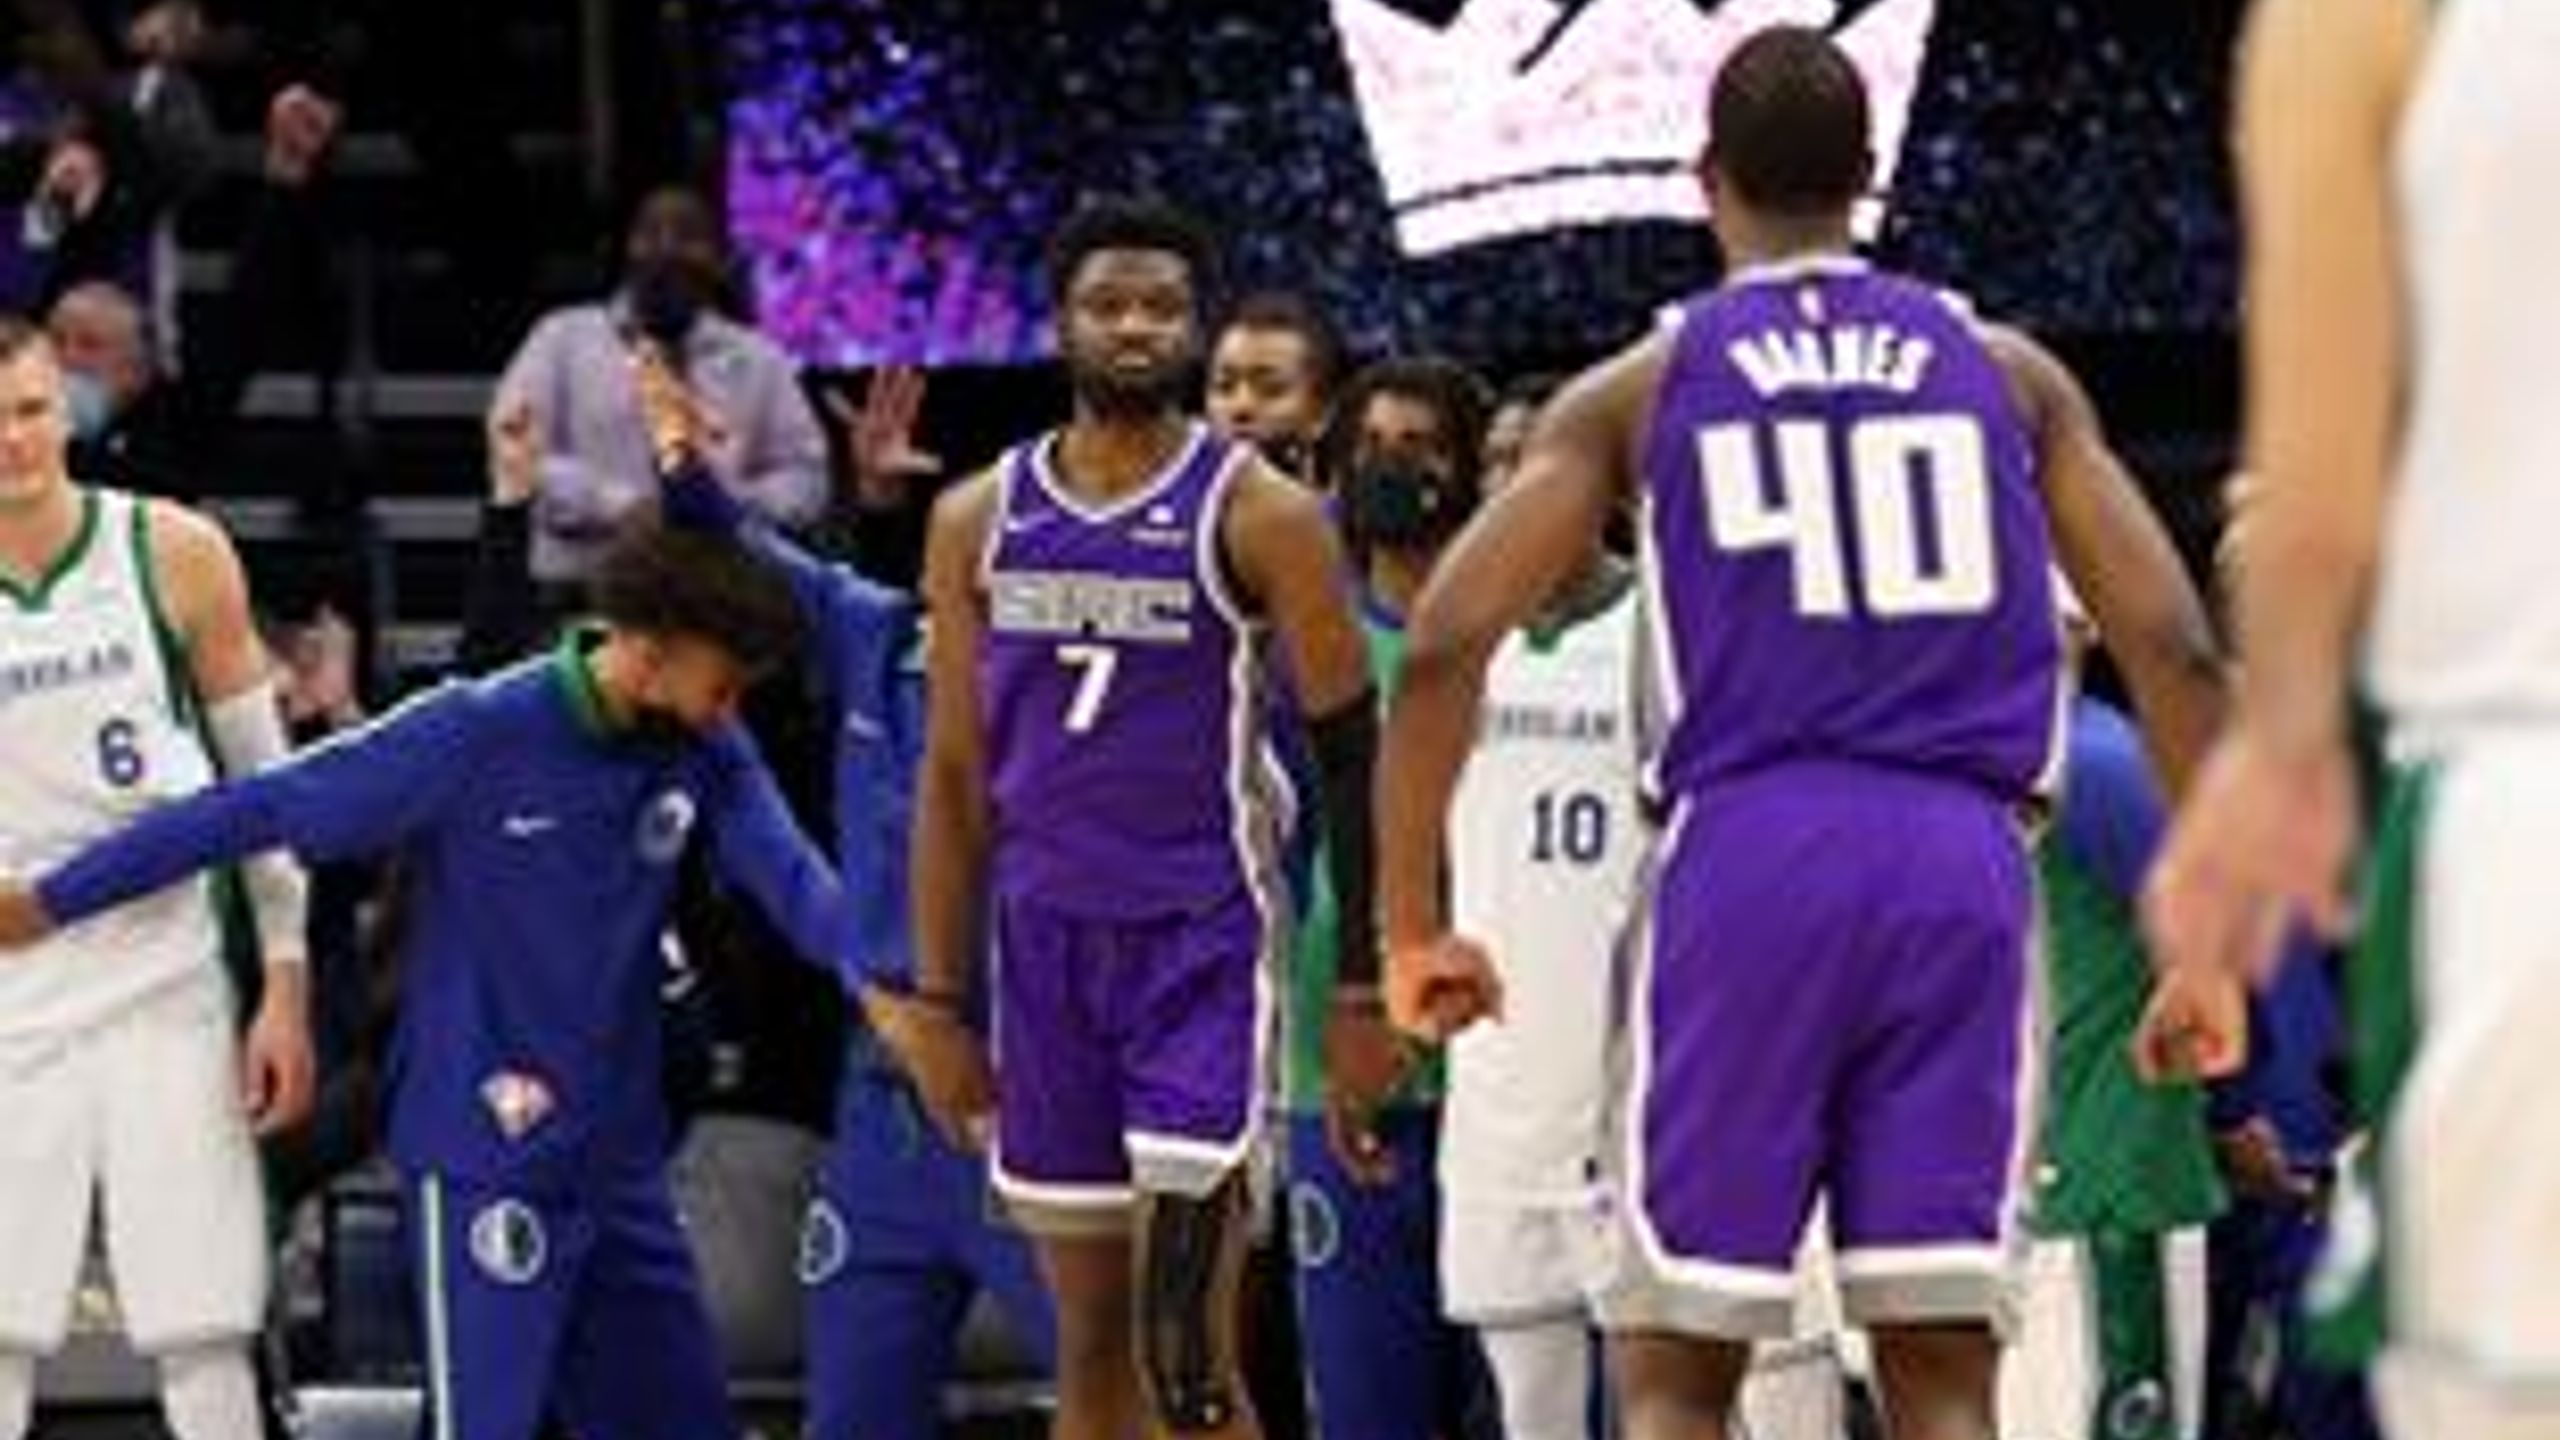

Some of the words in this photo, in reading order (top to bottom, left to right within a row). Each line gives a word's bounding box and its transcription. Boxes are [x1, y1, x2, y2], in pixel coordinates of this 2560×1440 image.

[1698, 415, 1995, 618] 40
[1056, 644, 1117, 731] 7
[99, 719, 143, 786] 6
[1531, 791, 1606, 862] 10
